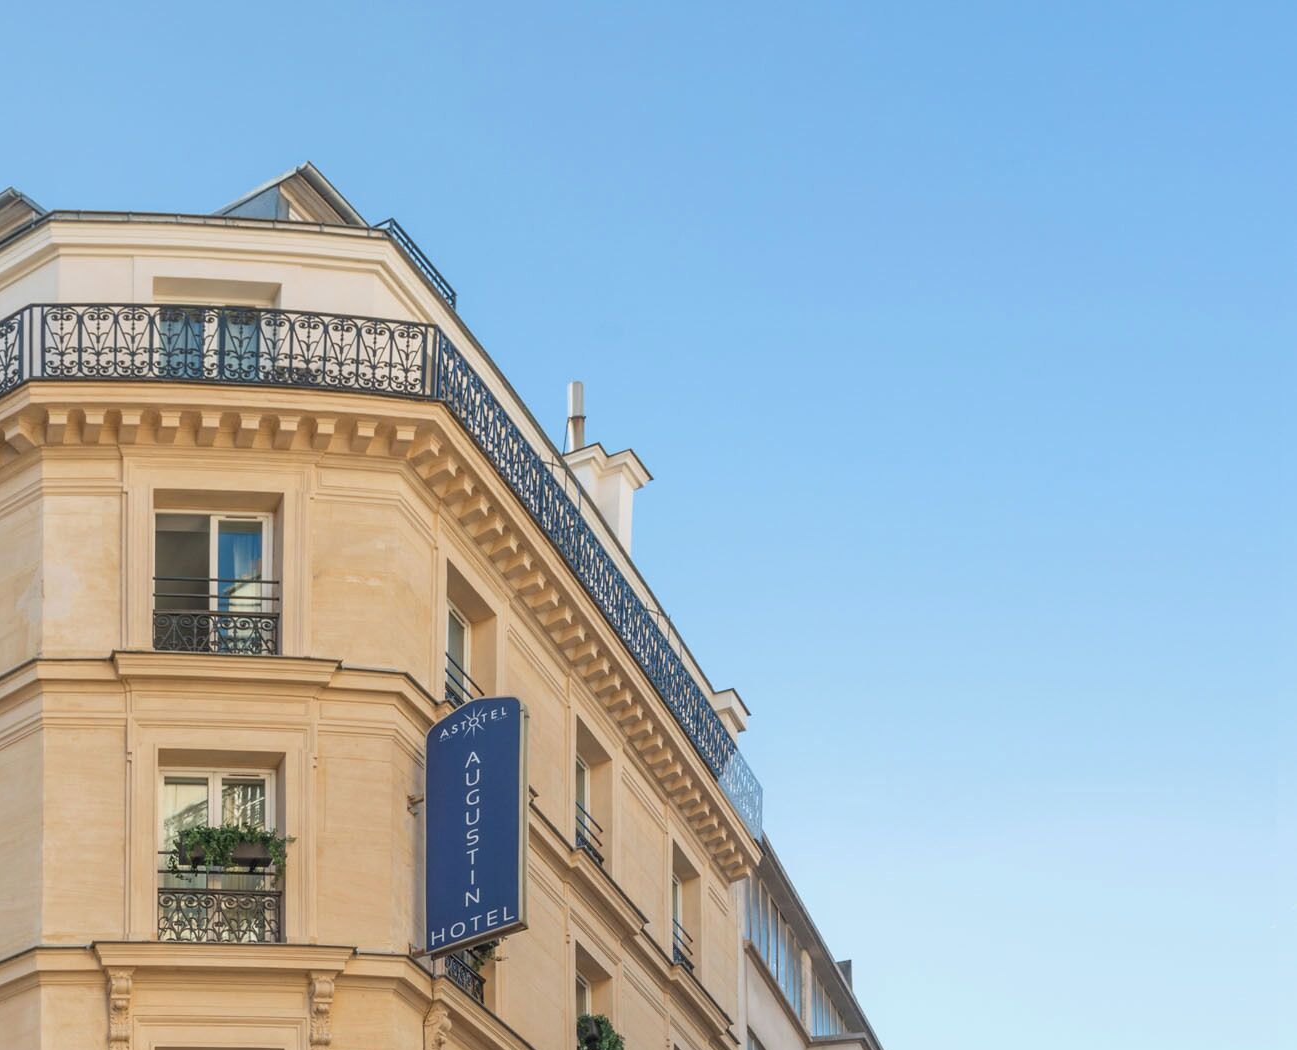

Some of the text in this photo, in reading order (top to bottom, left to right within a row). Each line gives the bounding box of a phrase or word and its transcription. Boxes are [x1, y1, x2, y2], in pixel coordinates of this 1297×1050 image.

[440, 706, 507, 739] ASTOTEL
[465, 751, 481, 907] AUGUSTIN
[431, 907, 515, 946] HOTEL
